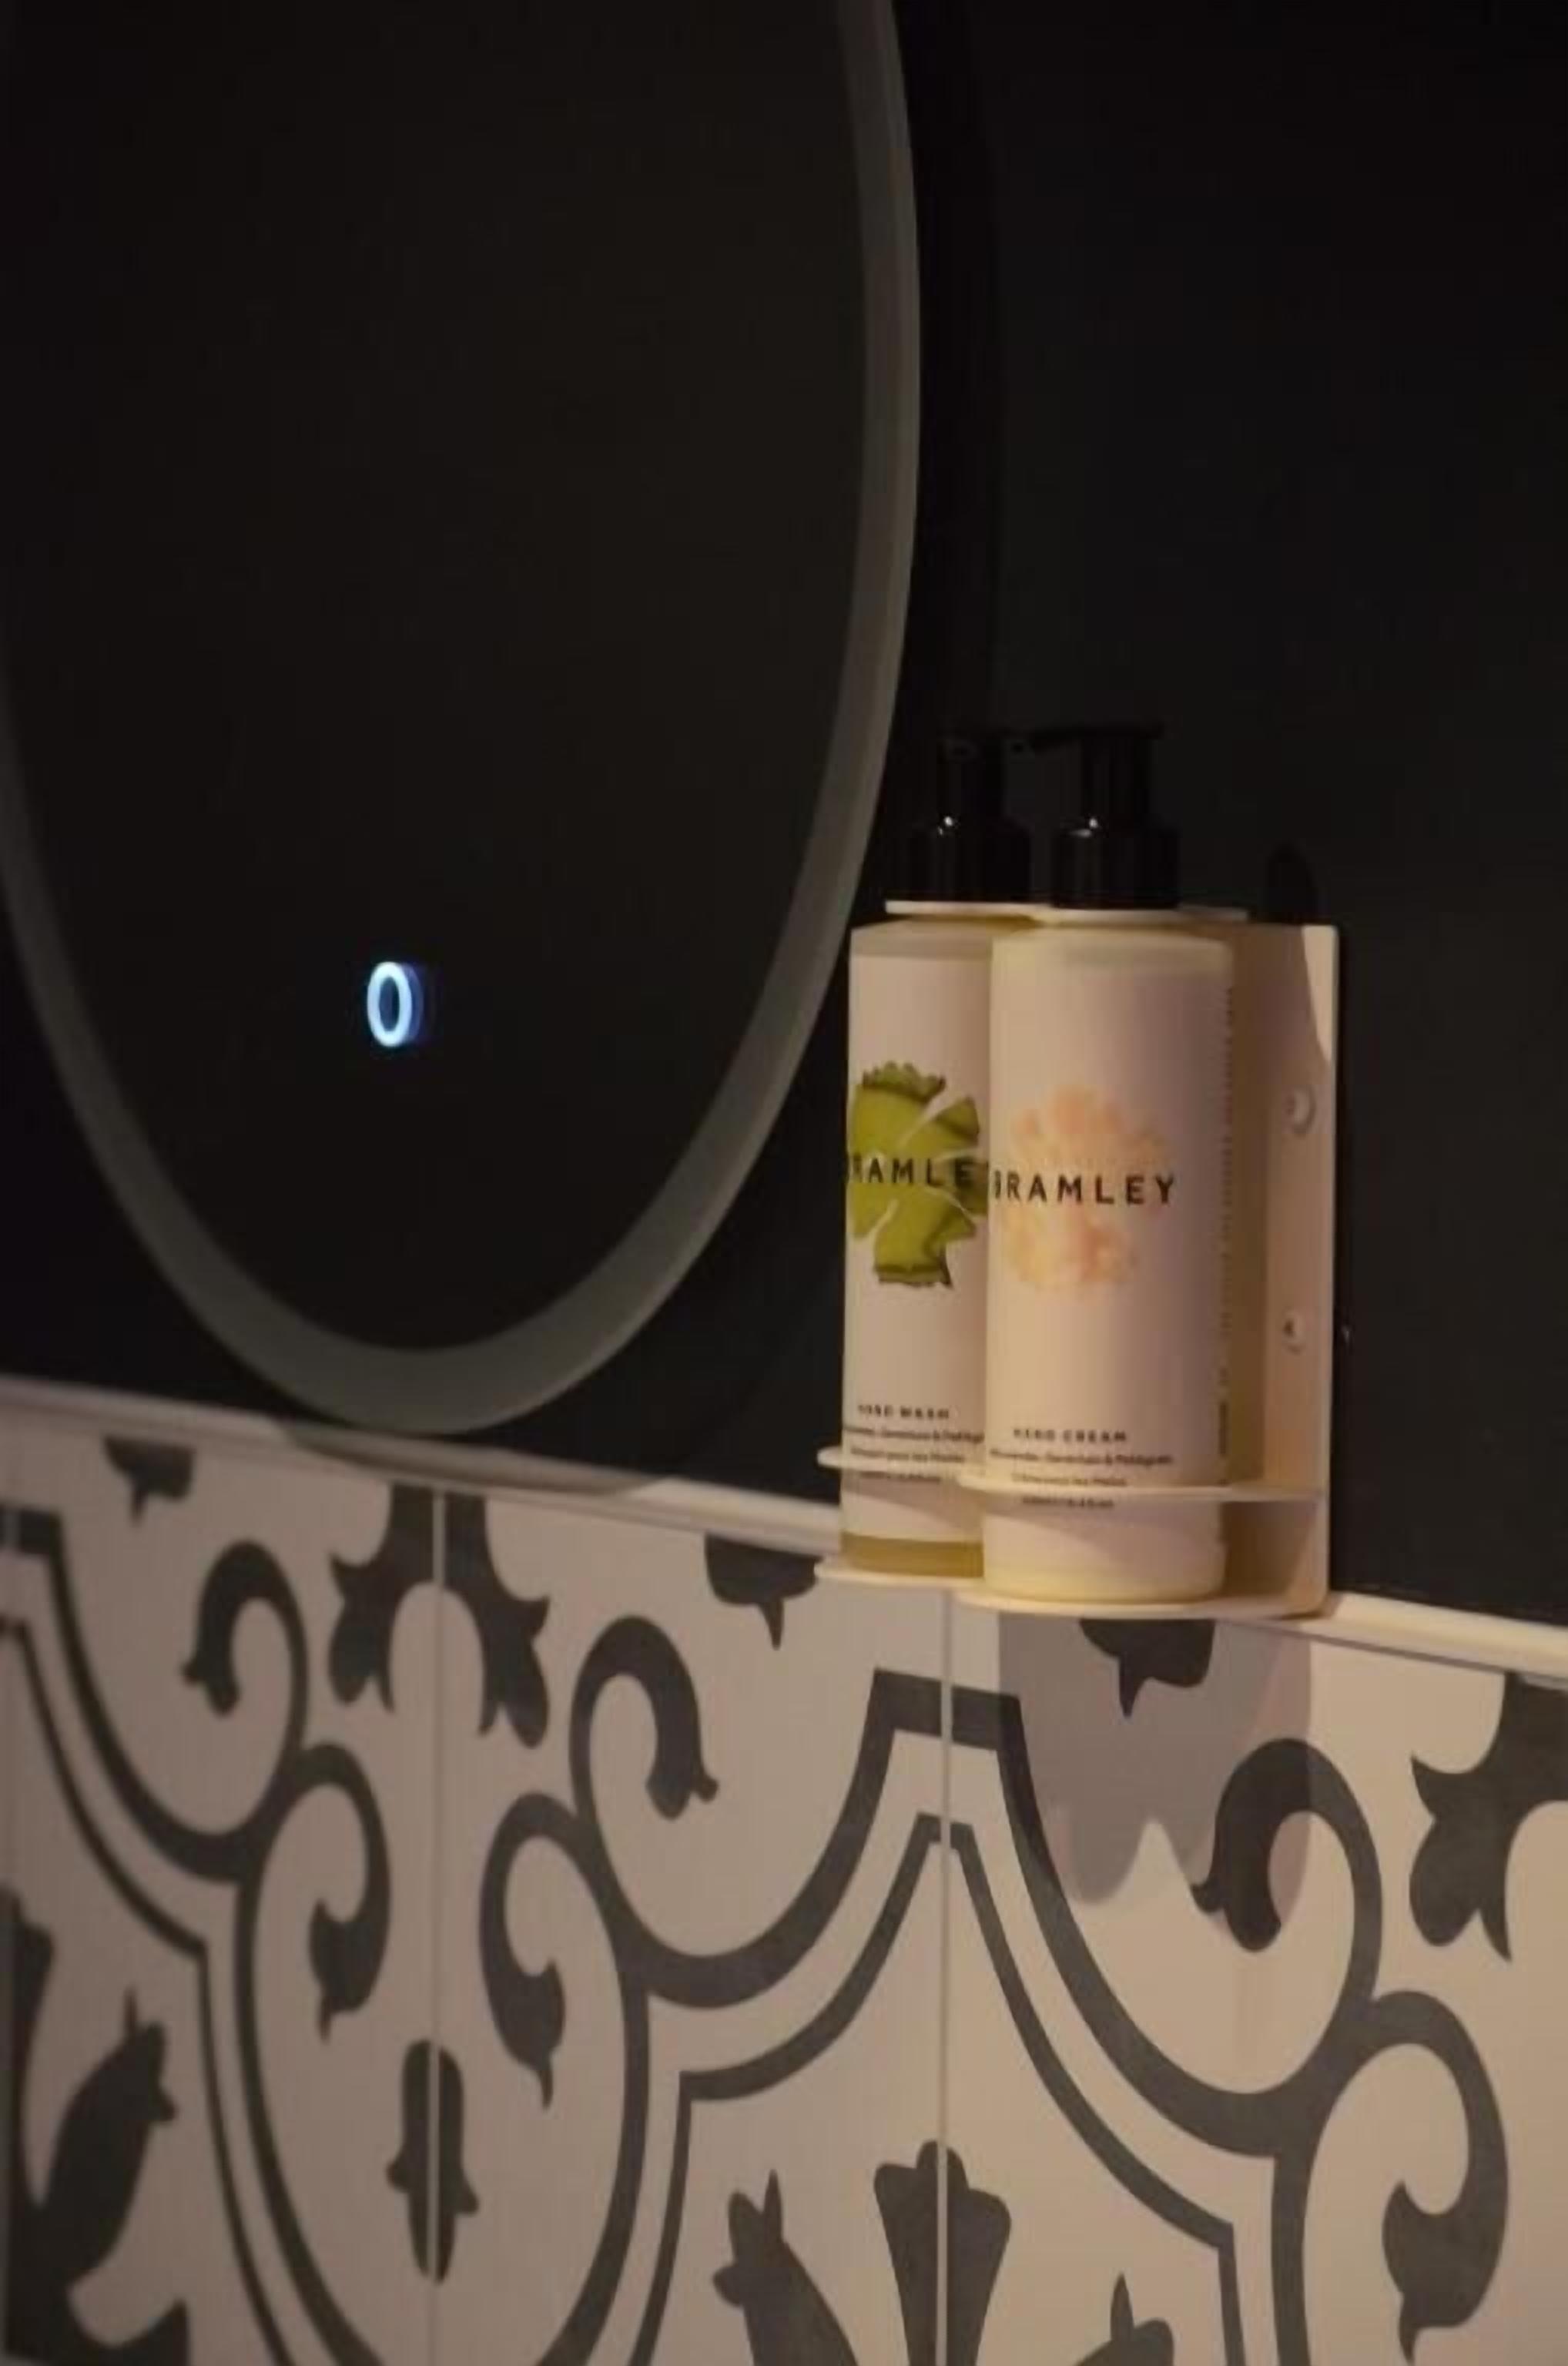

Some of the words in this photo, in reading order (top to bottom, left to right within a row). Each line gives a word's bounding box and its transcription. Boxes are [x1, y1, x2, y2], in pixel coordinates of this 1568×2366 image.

[846, 1155, 989, 1191] RAMLE
[994, 1169, 1174, 1205] BRAMLEY
[1064, 1430, 1126, 1443] CREAM
